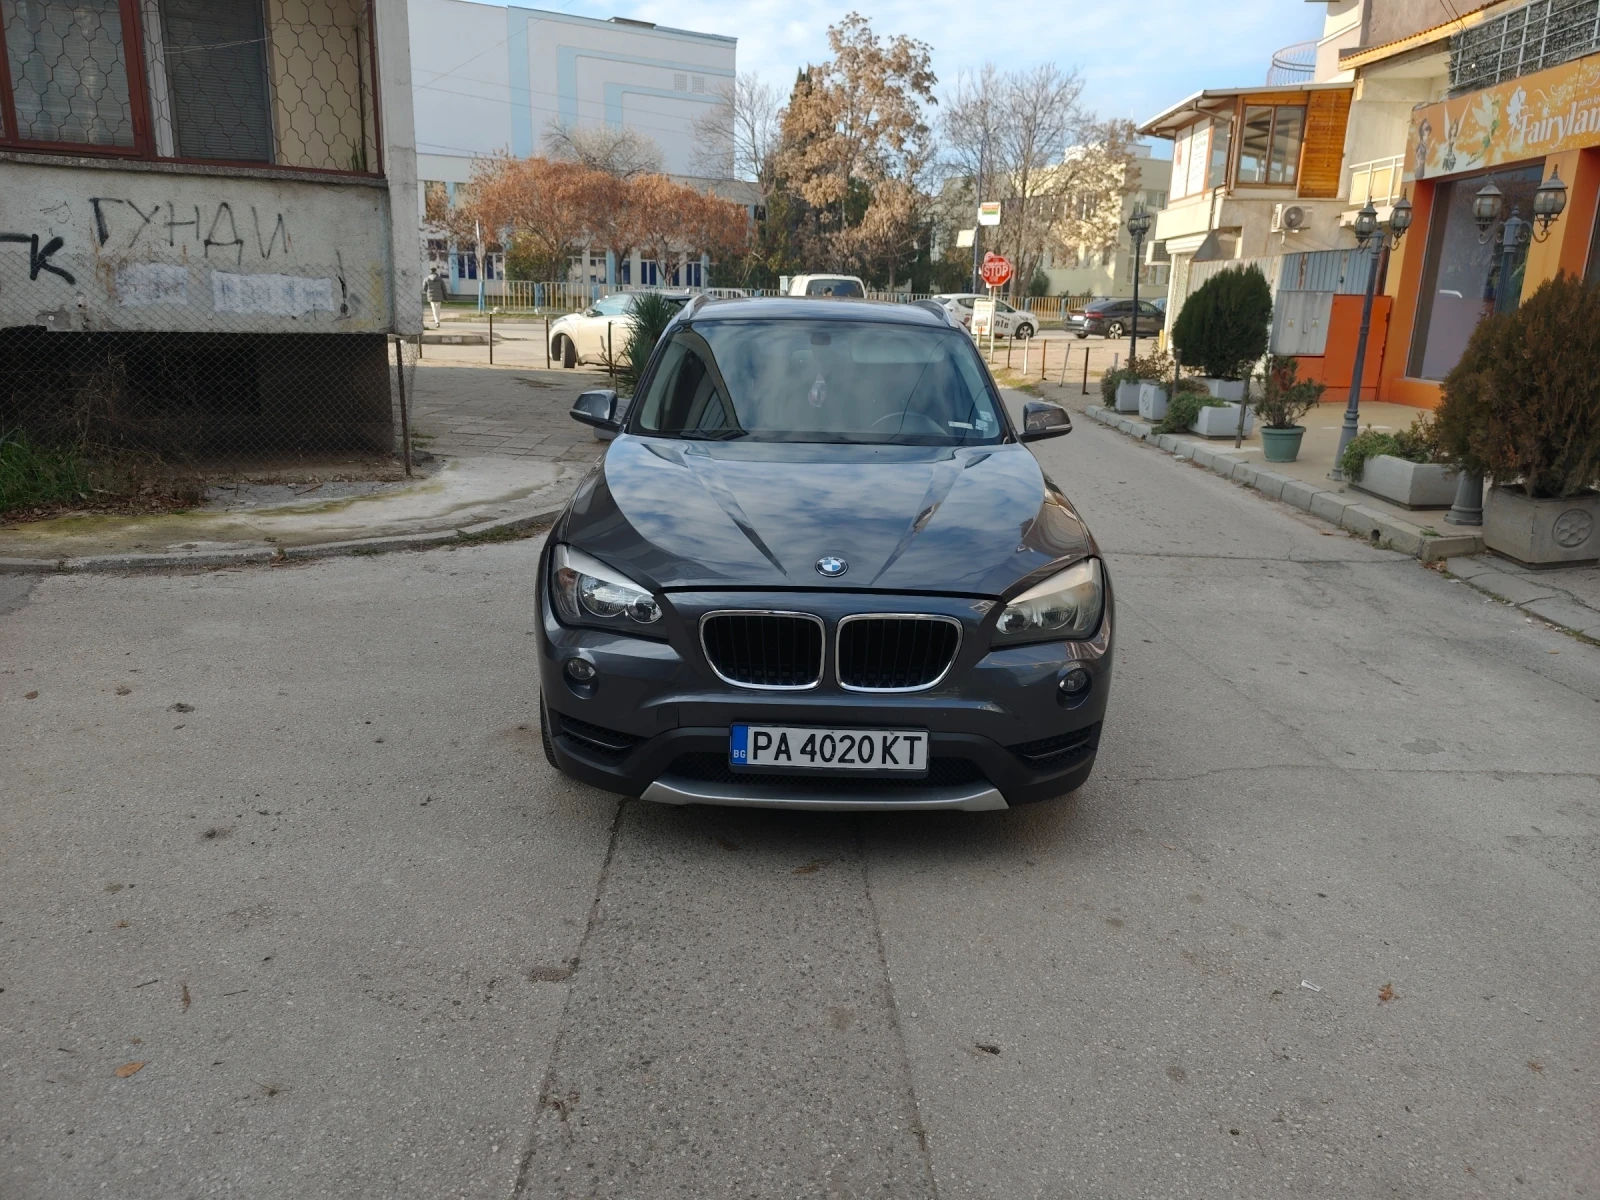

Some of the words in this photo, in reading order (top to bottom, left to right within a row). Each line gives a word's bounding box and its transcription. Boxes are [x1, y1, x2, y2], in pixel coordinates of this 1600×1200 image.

[983, 265, 1009, 277] STOP
[733, 749, 746, 758] BG
[752, 731, 792, 761] PA
[799, 733, 875, 764] 4020
[881, 735, 922, 765] KT
